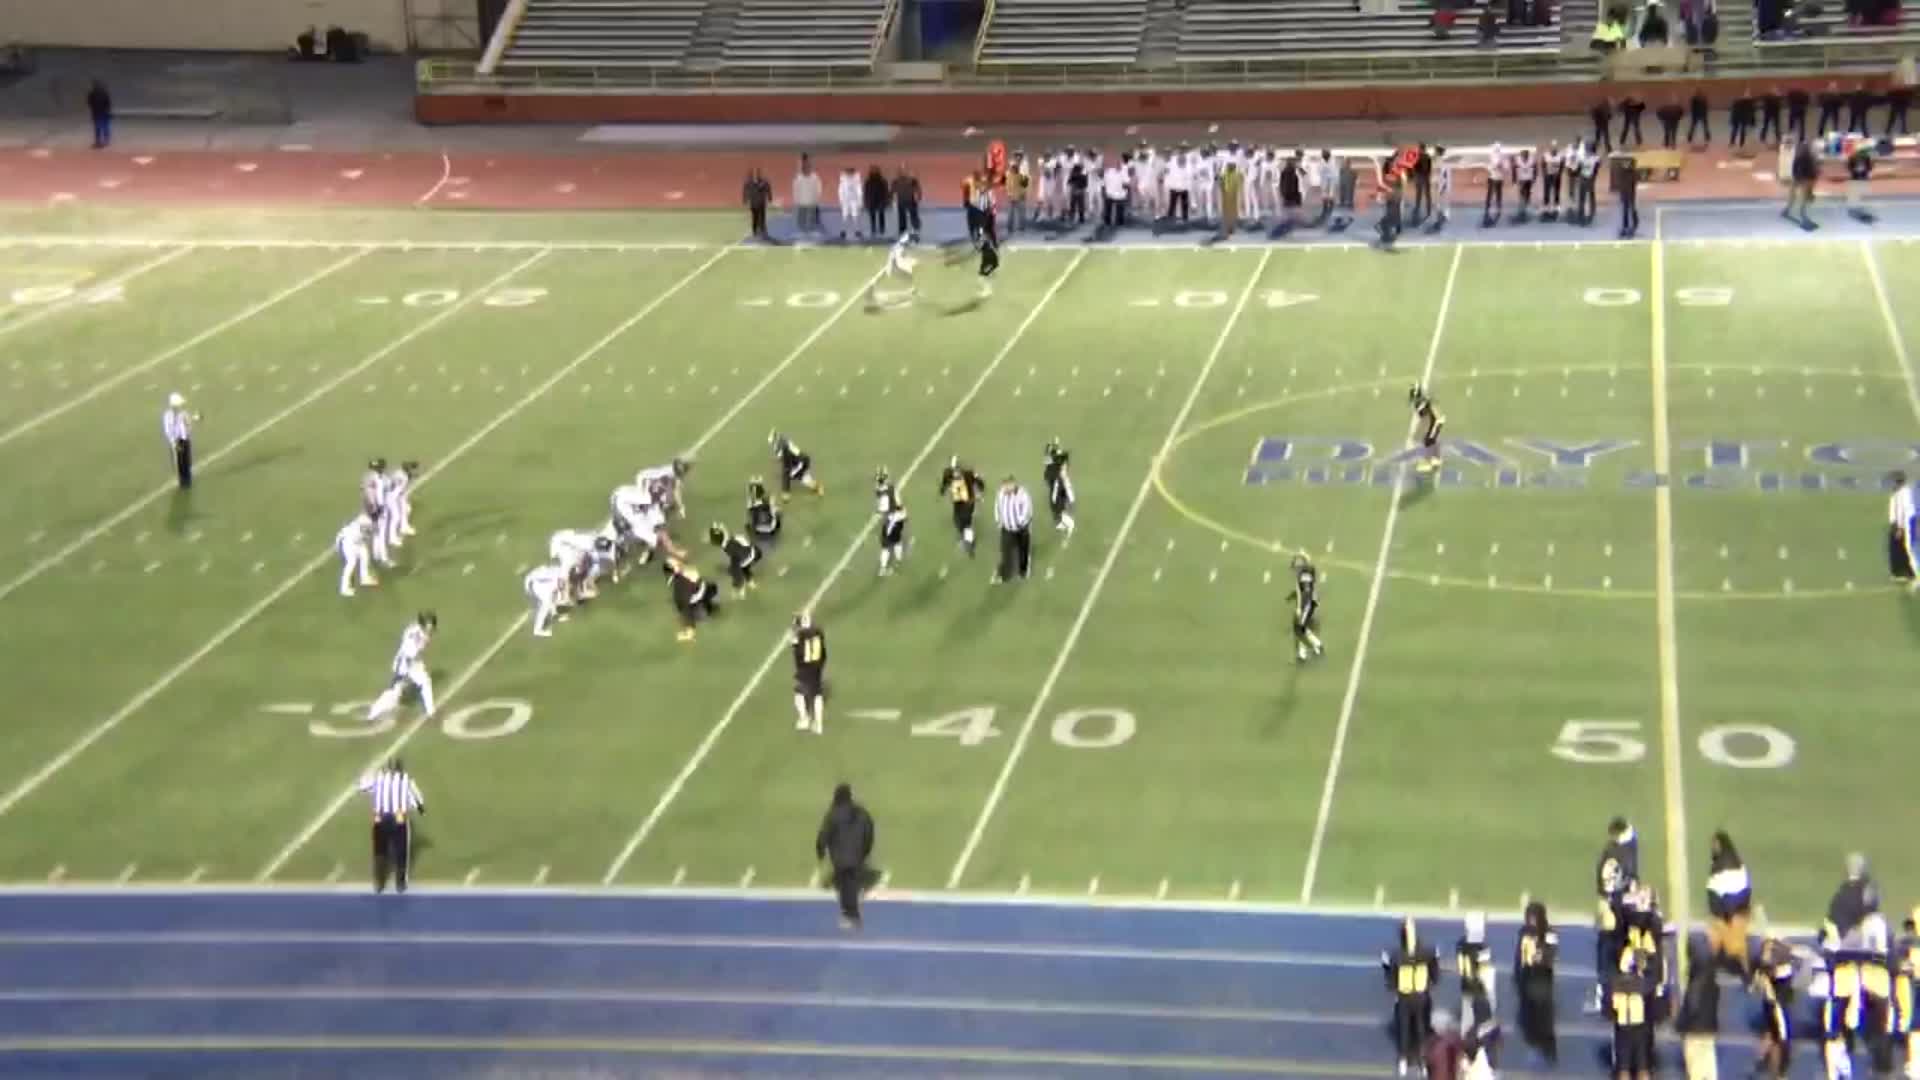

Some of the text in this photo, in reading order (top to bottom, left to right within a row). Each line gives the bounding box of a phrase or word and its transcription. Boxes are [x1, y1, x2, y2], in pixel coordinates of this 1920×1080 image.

[1583, 287, 1735, 307] 50
[306, 698, 533, 740] 30
[910, 705, 1137, 748] 40
[1546, 719, 1796, 769] 50
